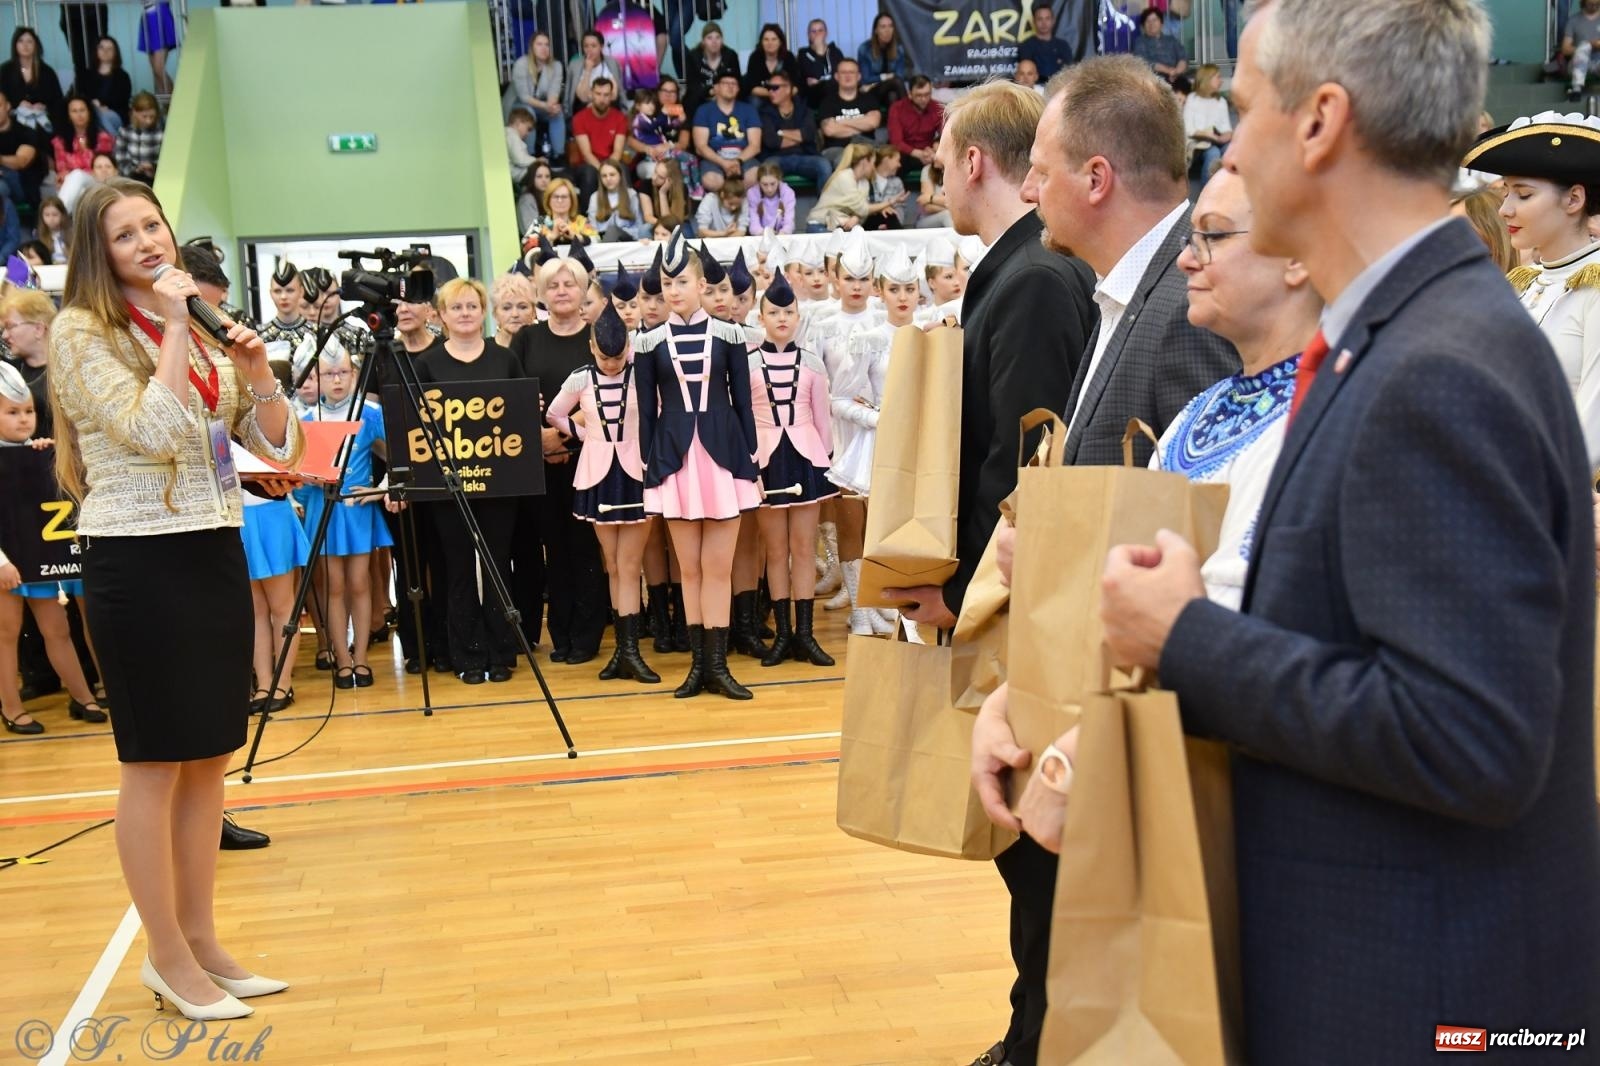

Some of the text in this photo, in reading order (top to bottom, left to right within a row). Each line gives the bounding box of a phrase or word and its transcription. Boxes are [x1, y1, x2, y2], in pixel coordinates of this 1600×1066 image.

[967, 46, 1018, 58] RACIBÓRZ
[944, 64, 988, 76] ZAWADA
[419, 388, 505, 432] Spec
[407, 425, 523, 463] Babcie
